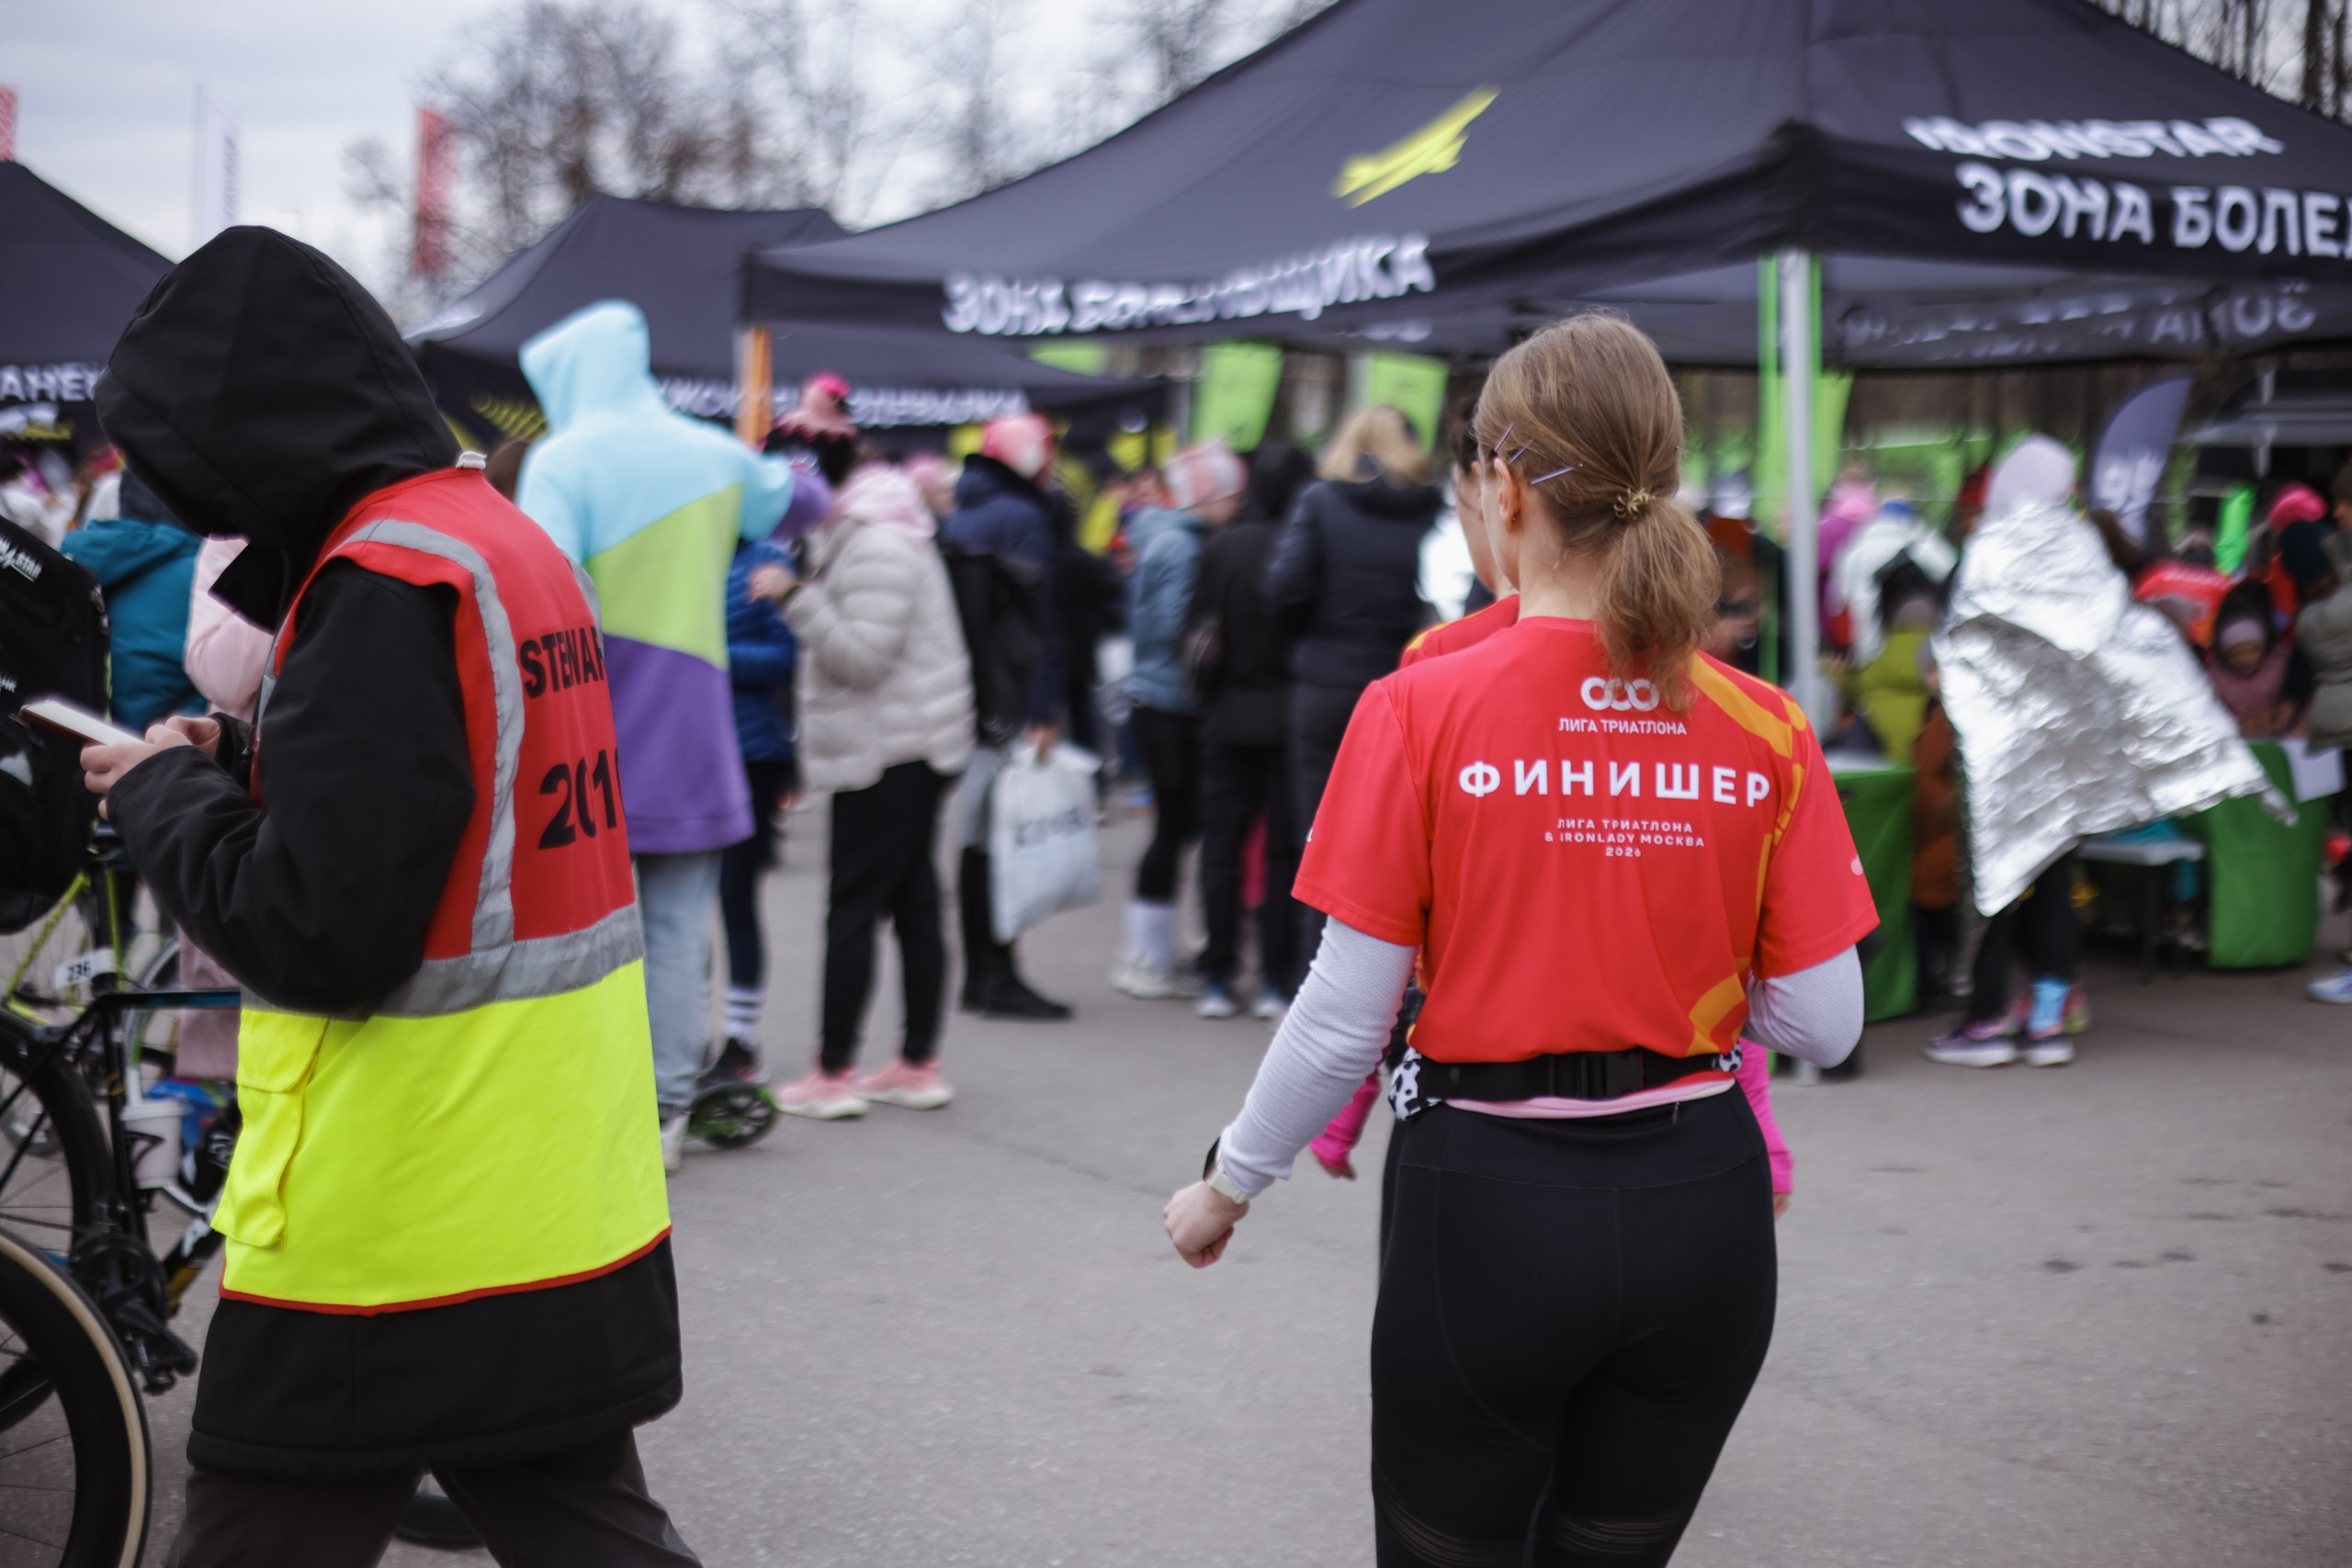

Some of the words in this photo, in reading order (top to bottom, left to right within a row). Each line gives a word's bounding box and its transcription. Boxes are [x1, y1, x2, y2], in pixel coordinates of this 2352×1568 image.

[1955, 161, 2155, 244] ЗОНА
[2171, 184, 2352, 261] БОЛЕ
[1558, 717, 1598, 733] ЛИГА
[1600, 718, 1688, 735] ТРИАТЛОНА
[1459, 760, 1770, 807] ФИНИШЕР
[538, 747, 626, 850] 201
[1557, 818, 1596, 829] ЛИГА
[1602, 819, 1693, 833] ТРИАТЛОНА
[1544, 831, 1554, 842] &
[1560, 832, 1635, 844] IRONLADY
[1640, 834, 1705, 847] МОСКВА
[1605, 847, 1642, 857] 2026
